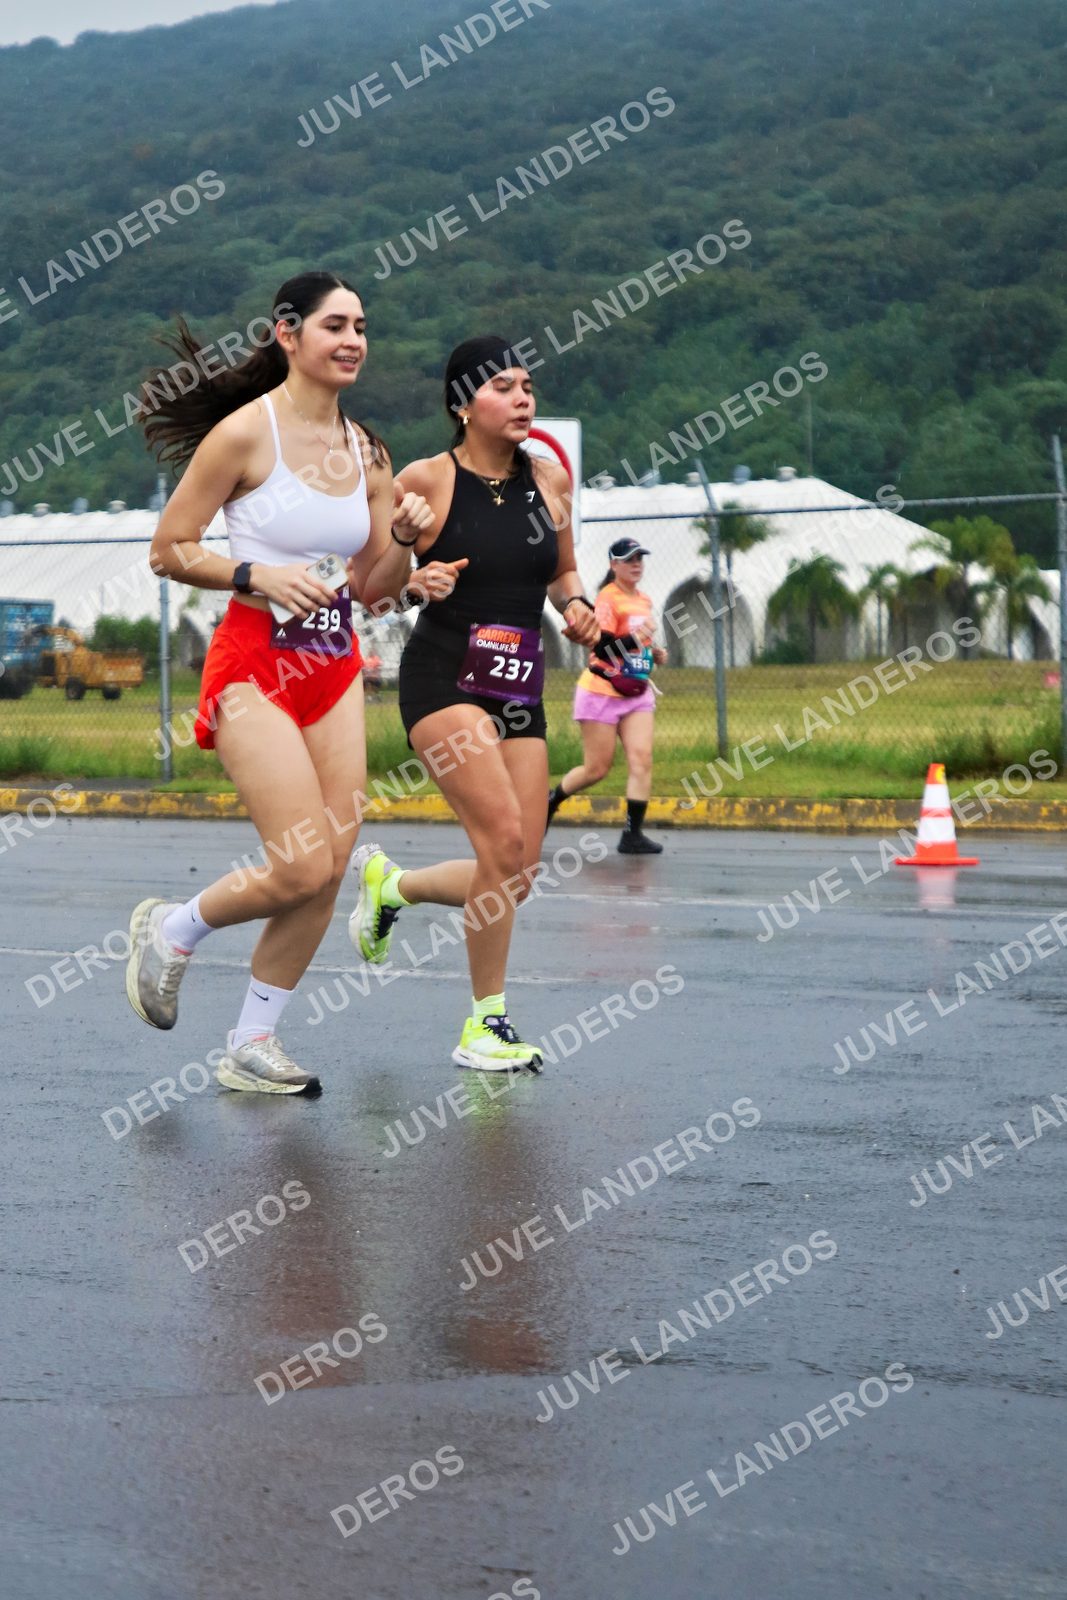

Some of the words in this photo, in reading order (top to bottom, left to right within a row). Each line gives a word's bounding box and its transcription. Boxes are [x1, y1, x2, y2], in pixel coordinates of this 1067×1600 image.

[302, 608, 342, 632] 239
[477, 628, 521, 643] CARRERA
[476, 639, 510, 652] OMNILIFE
[489, 656, 534, 683] 237
